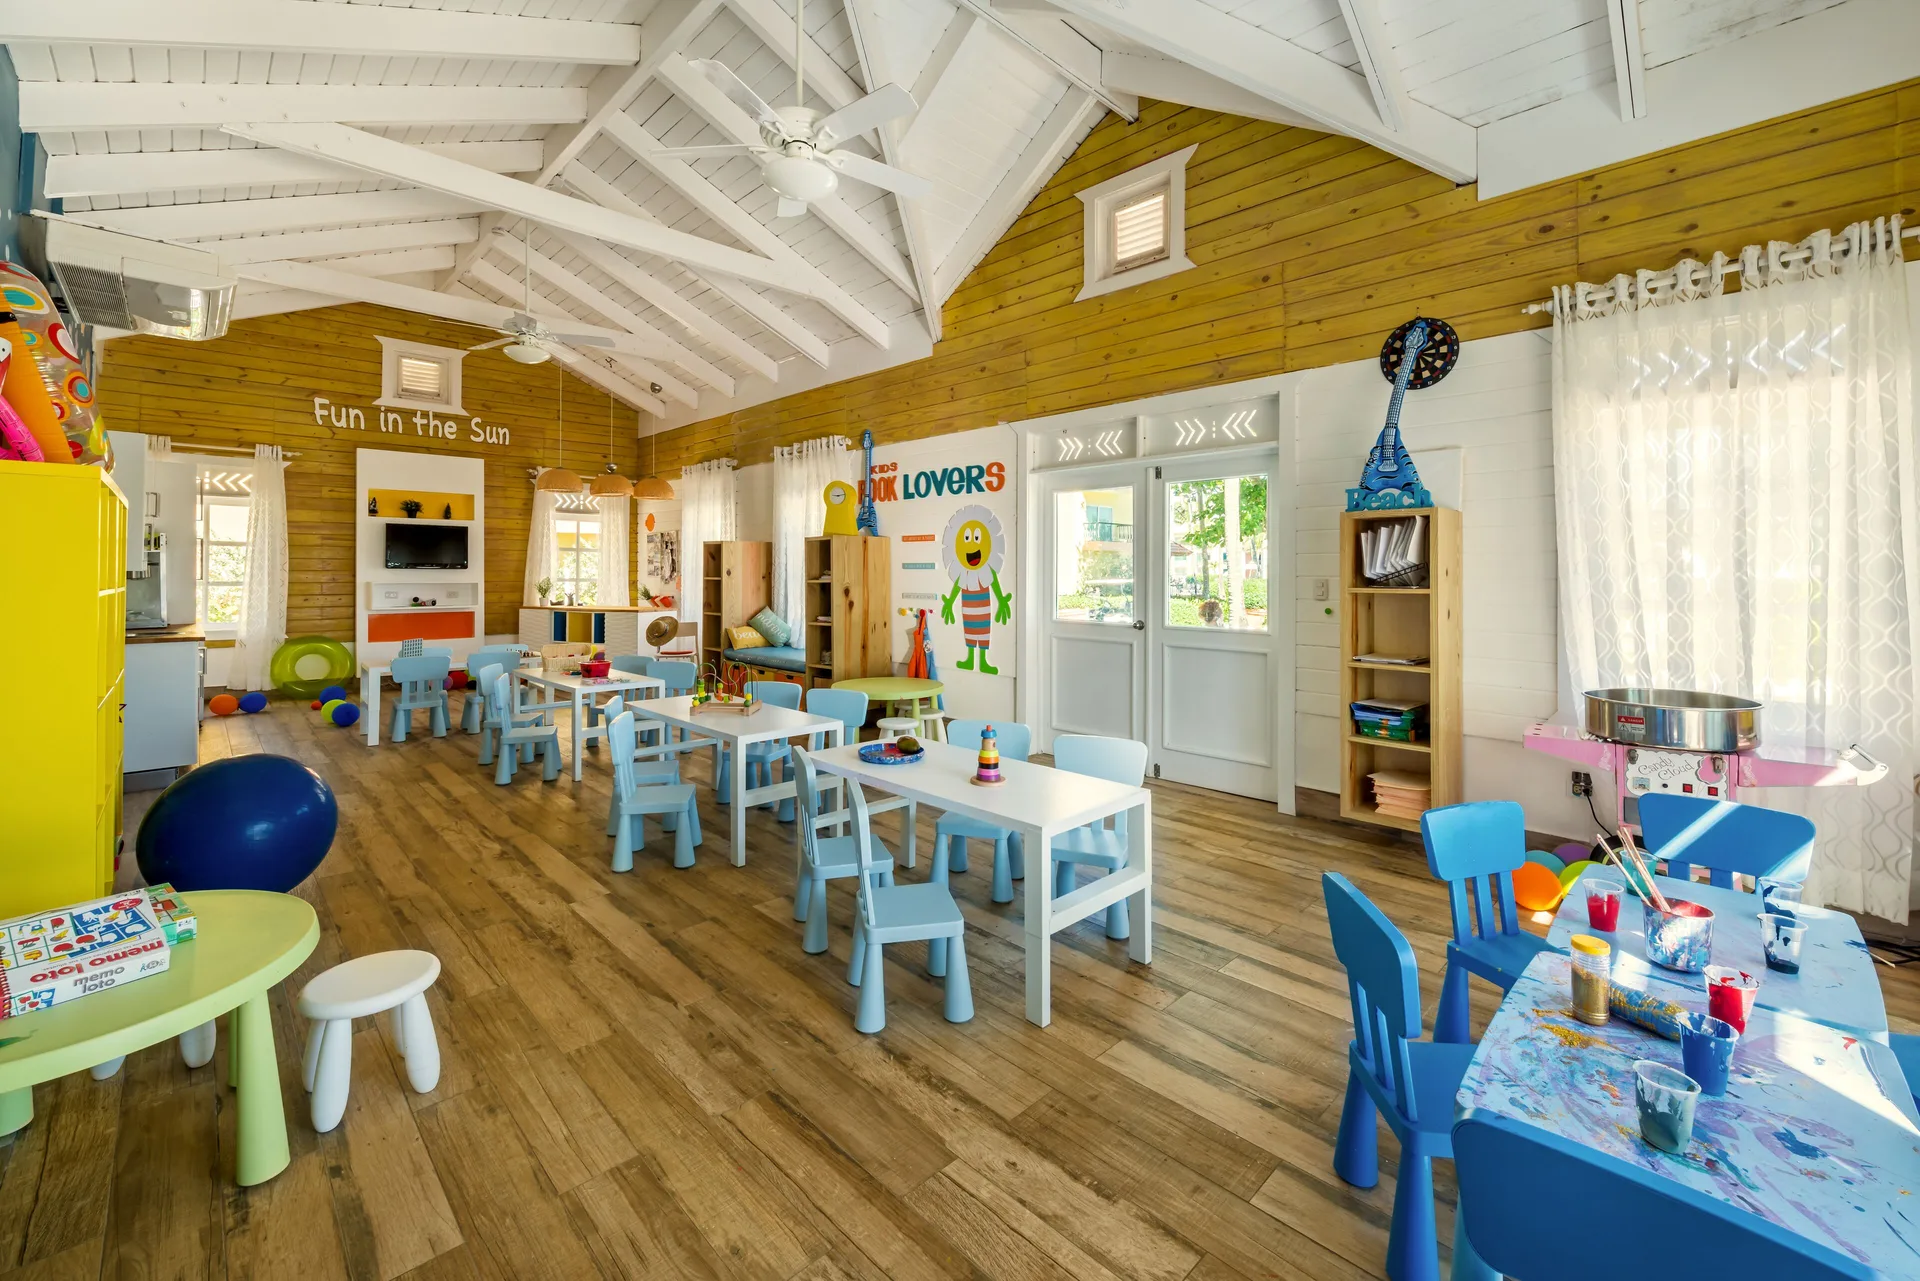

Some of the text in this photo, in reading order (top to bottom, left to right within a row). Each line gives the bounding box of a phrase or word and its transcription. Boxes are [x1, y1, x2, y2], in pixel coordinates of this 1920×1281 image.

[314, 397, 510, 445] Fun in the Sun
[870, 462, 898, 475] KIDS
[1345, 483, 1433, 513] Beach
[1638, 756, 1675, 776] Candy
[1658, 759, 1695, 781] Cloud
[89, 940, 164, 967] memo
[29, 963, 85, 983] loto
[73, 966, 125, 987] memo
[82, 978, 116, 994] loto
